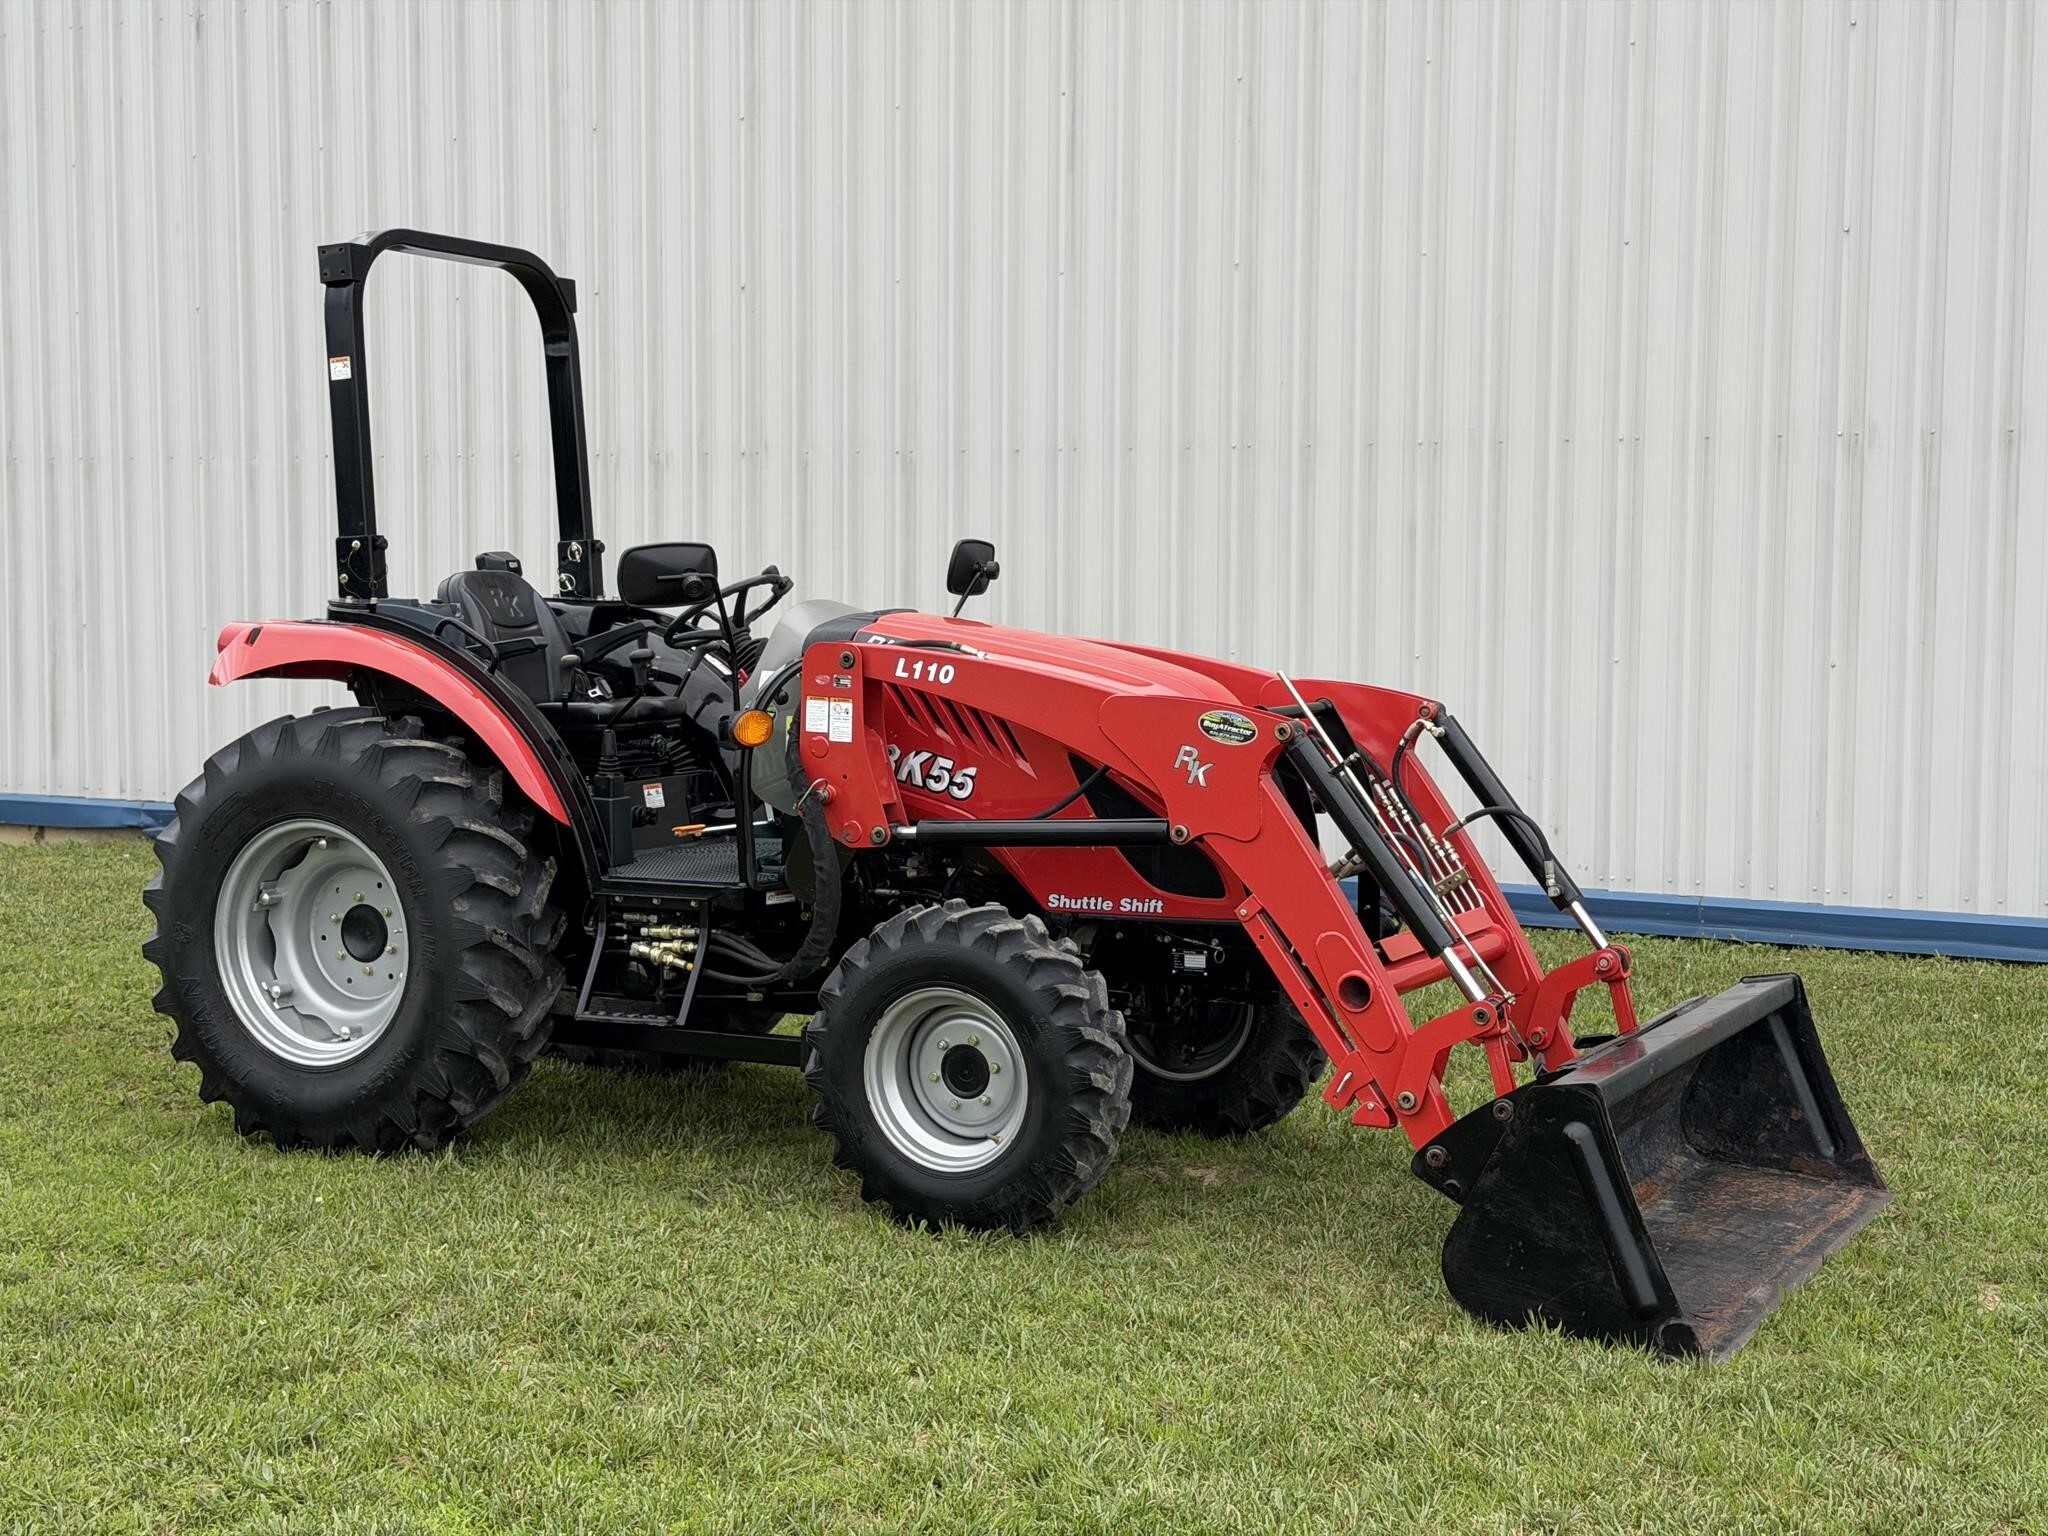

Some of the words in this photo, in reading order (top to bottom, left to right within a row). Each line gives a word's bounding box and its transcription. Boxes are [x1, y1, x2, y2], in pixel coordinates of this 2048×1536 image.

[895, 657, 955, 684] L110
[1173, 744, 1215, 787] RK
[1047, 893, 1114, 911] Shuttle
[1119, 897, 1164, 913] Shift
